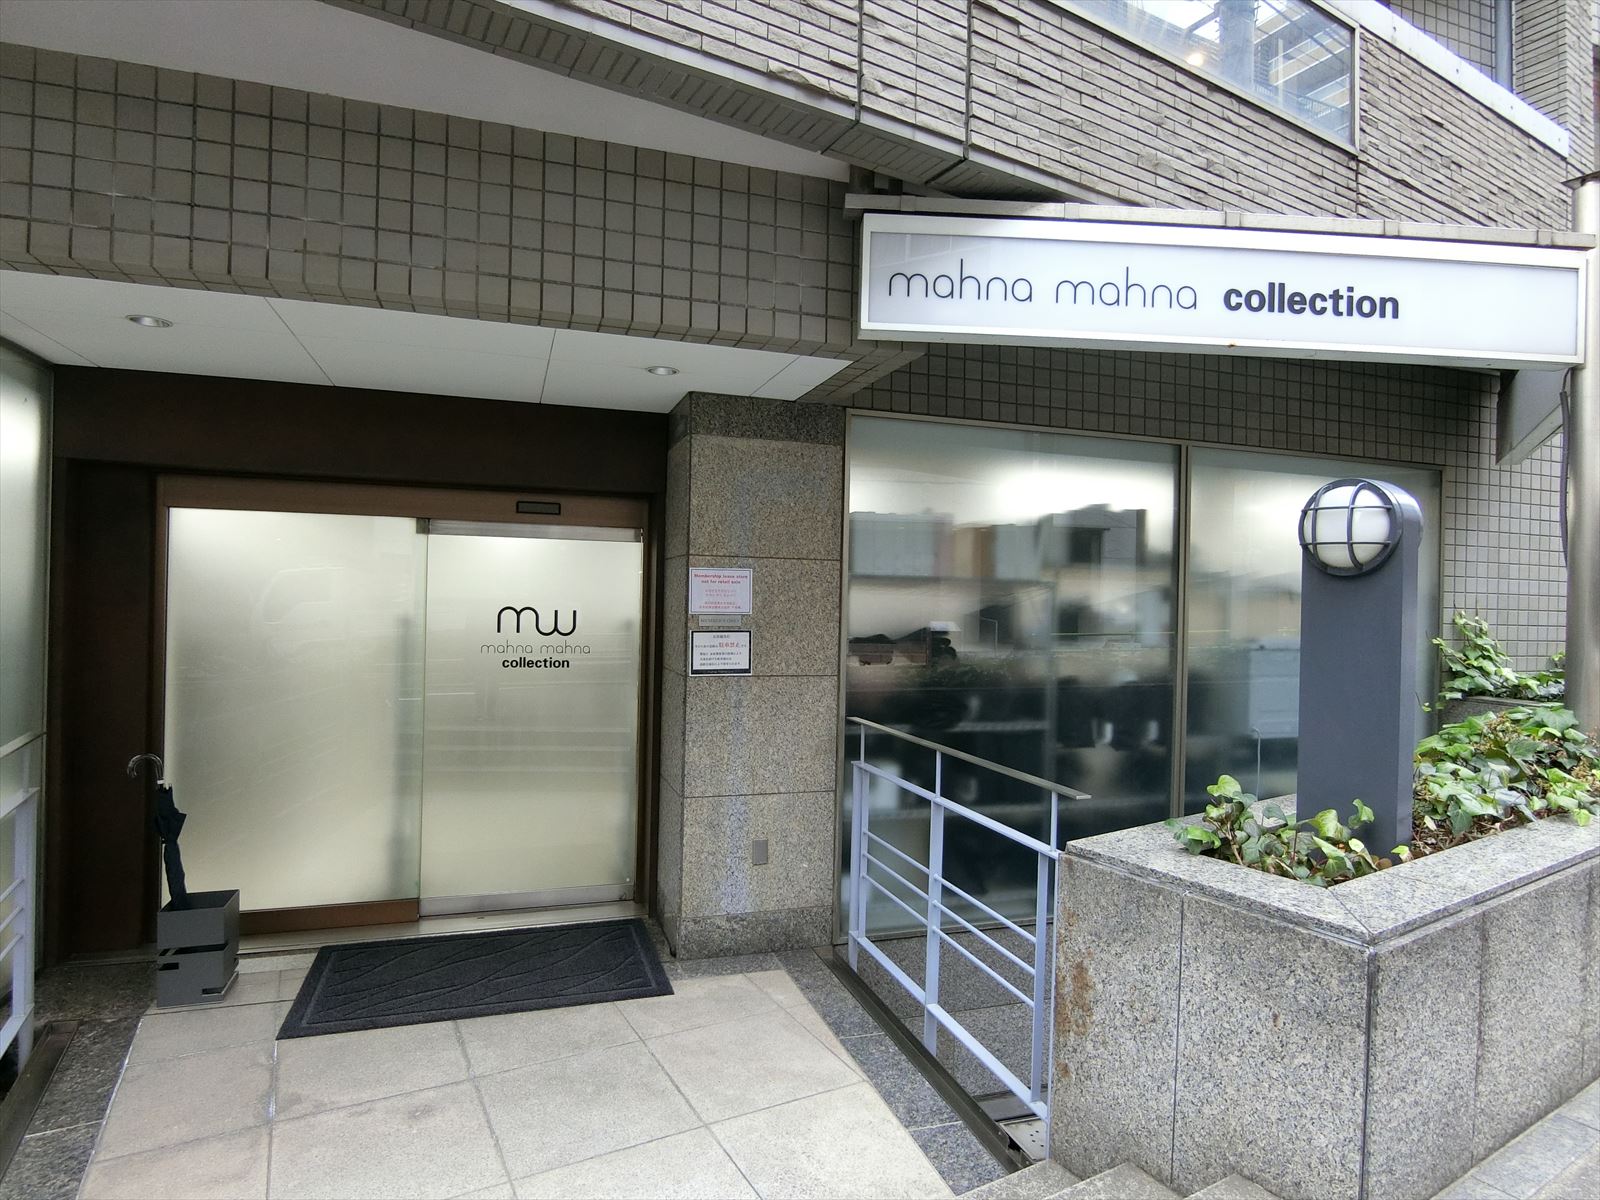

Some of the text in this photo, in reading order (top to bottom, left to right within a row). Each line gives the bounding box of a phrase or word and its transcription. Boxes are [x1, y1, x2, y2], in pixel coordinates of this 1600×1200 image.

[888, 258, 1400, 320] mahna mahna collection
[480, 640, 591, 654] mahna mahna
[502, 657, 570, 668] collection
